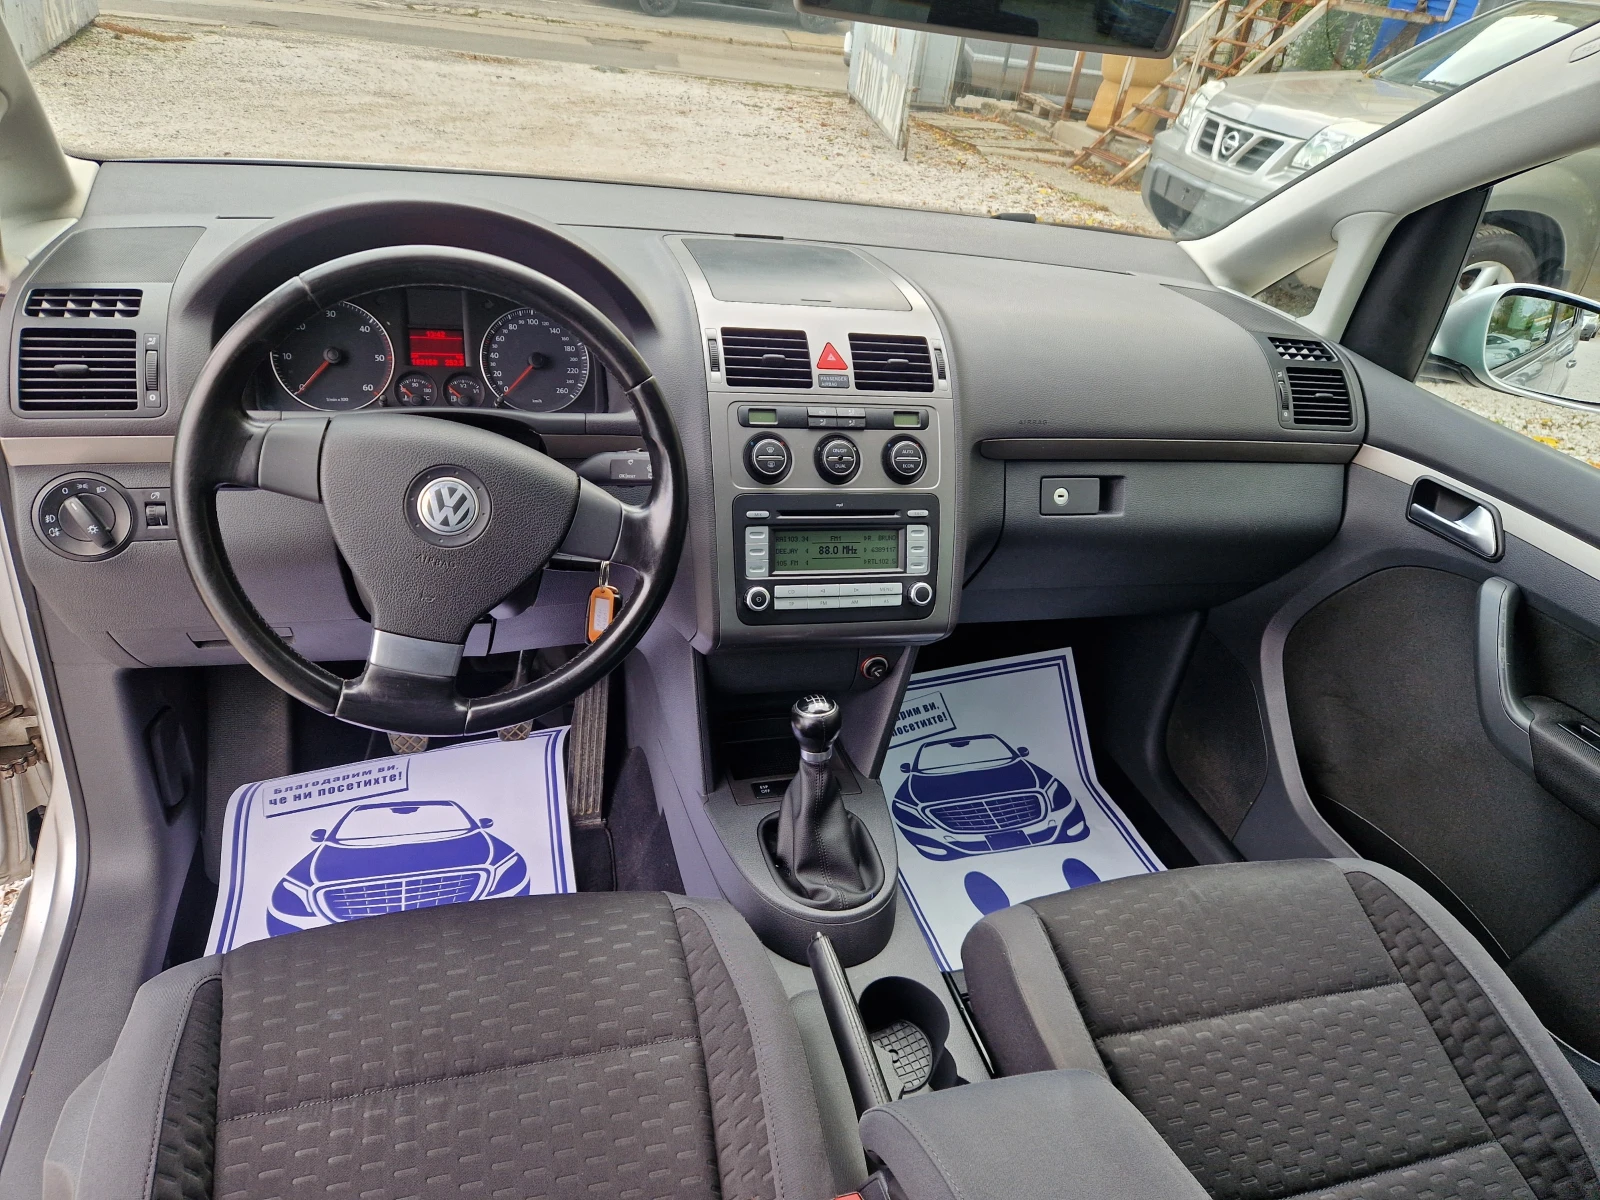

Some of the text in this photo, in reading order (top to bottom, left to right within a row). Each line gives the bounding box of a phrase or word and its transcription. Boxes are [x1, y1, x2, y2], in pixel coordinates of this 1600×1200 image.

[326, 310, 336, 318] 30
[359, 325, 370, 333] 40
[282, 352, 292, 360] 10
[374, 354, 385, 362] 50
[818, 545, 858, 555] 88.0 MHz
[922, 701, 940, 713] ви,
[273, 769, 372, 795] Благодарим
[268, 771, 402, 806] че ни посетихте!
